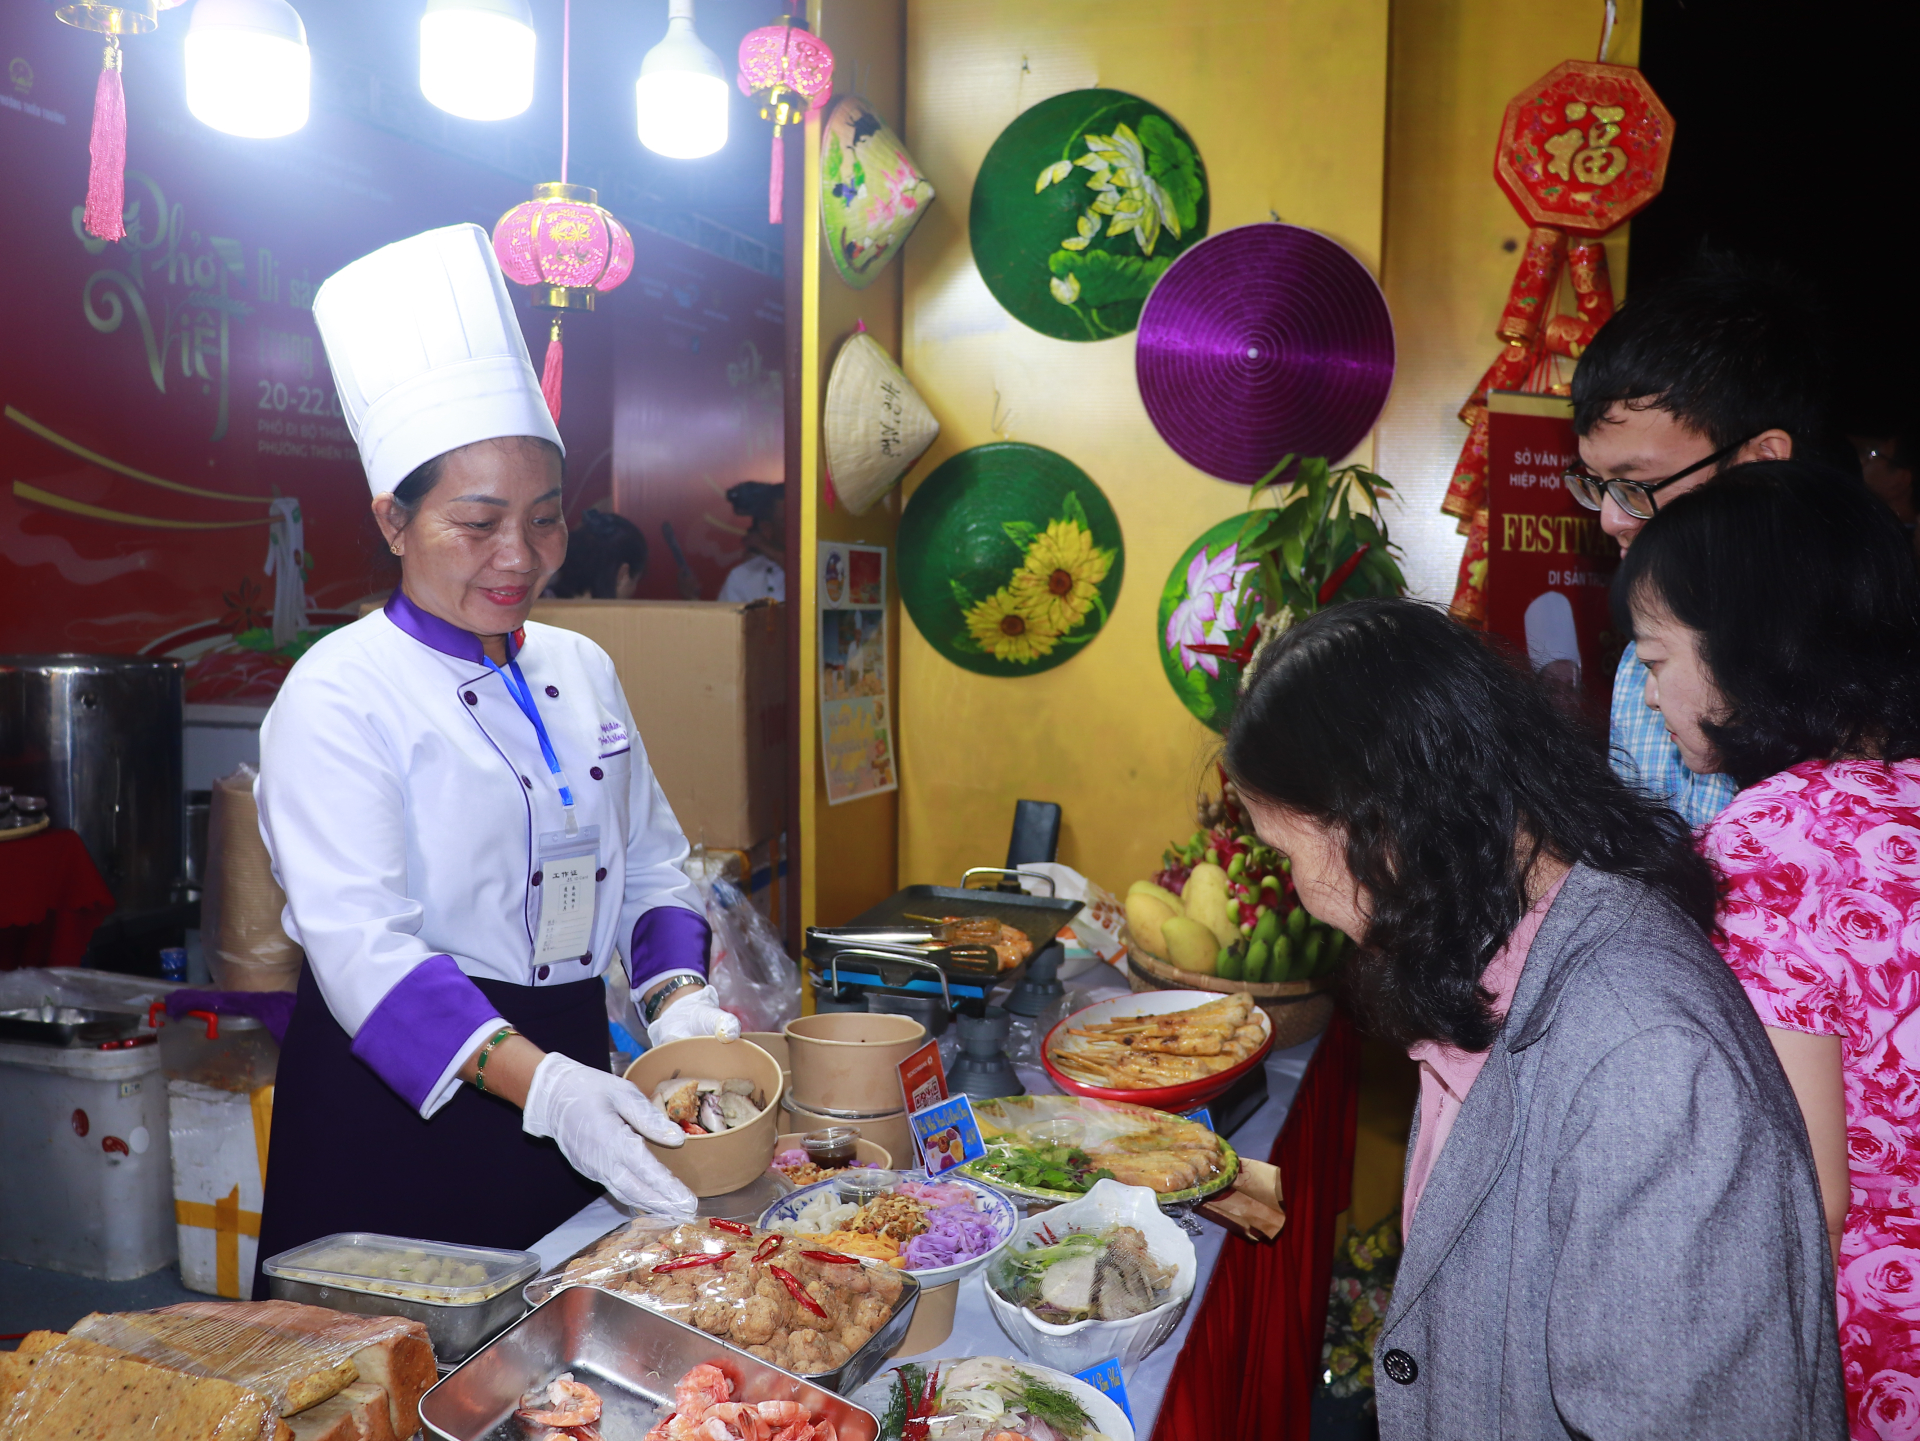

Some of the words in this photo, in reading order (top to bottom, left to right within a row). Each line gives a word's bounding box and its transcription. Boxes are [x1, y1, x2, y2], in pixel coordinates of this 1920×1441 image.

[1544, 102, 1628, 186] 福
[258, 247, 279, 303] Di
[289, 267, 318, 310] sả
[1514, 446, 1531, 465] SỞ
[1533, 449, 1558, 467] VĂN
[1509, 469, 1537, 490] HIỆP
[1539, 471, 1560, 492] HỘI
[1548, 570, 1560, 585] DI
[1563, 565, 1586, 586] SẢN
